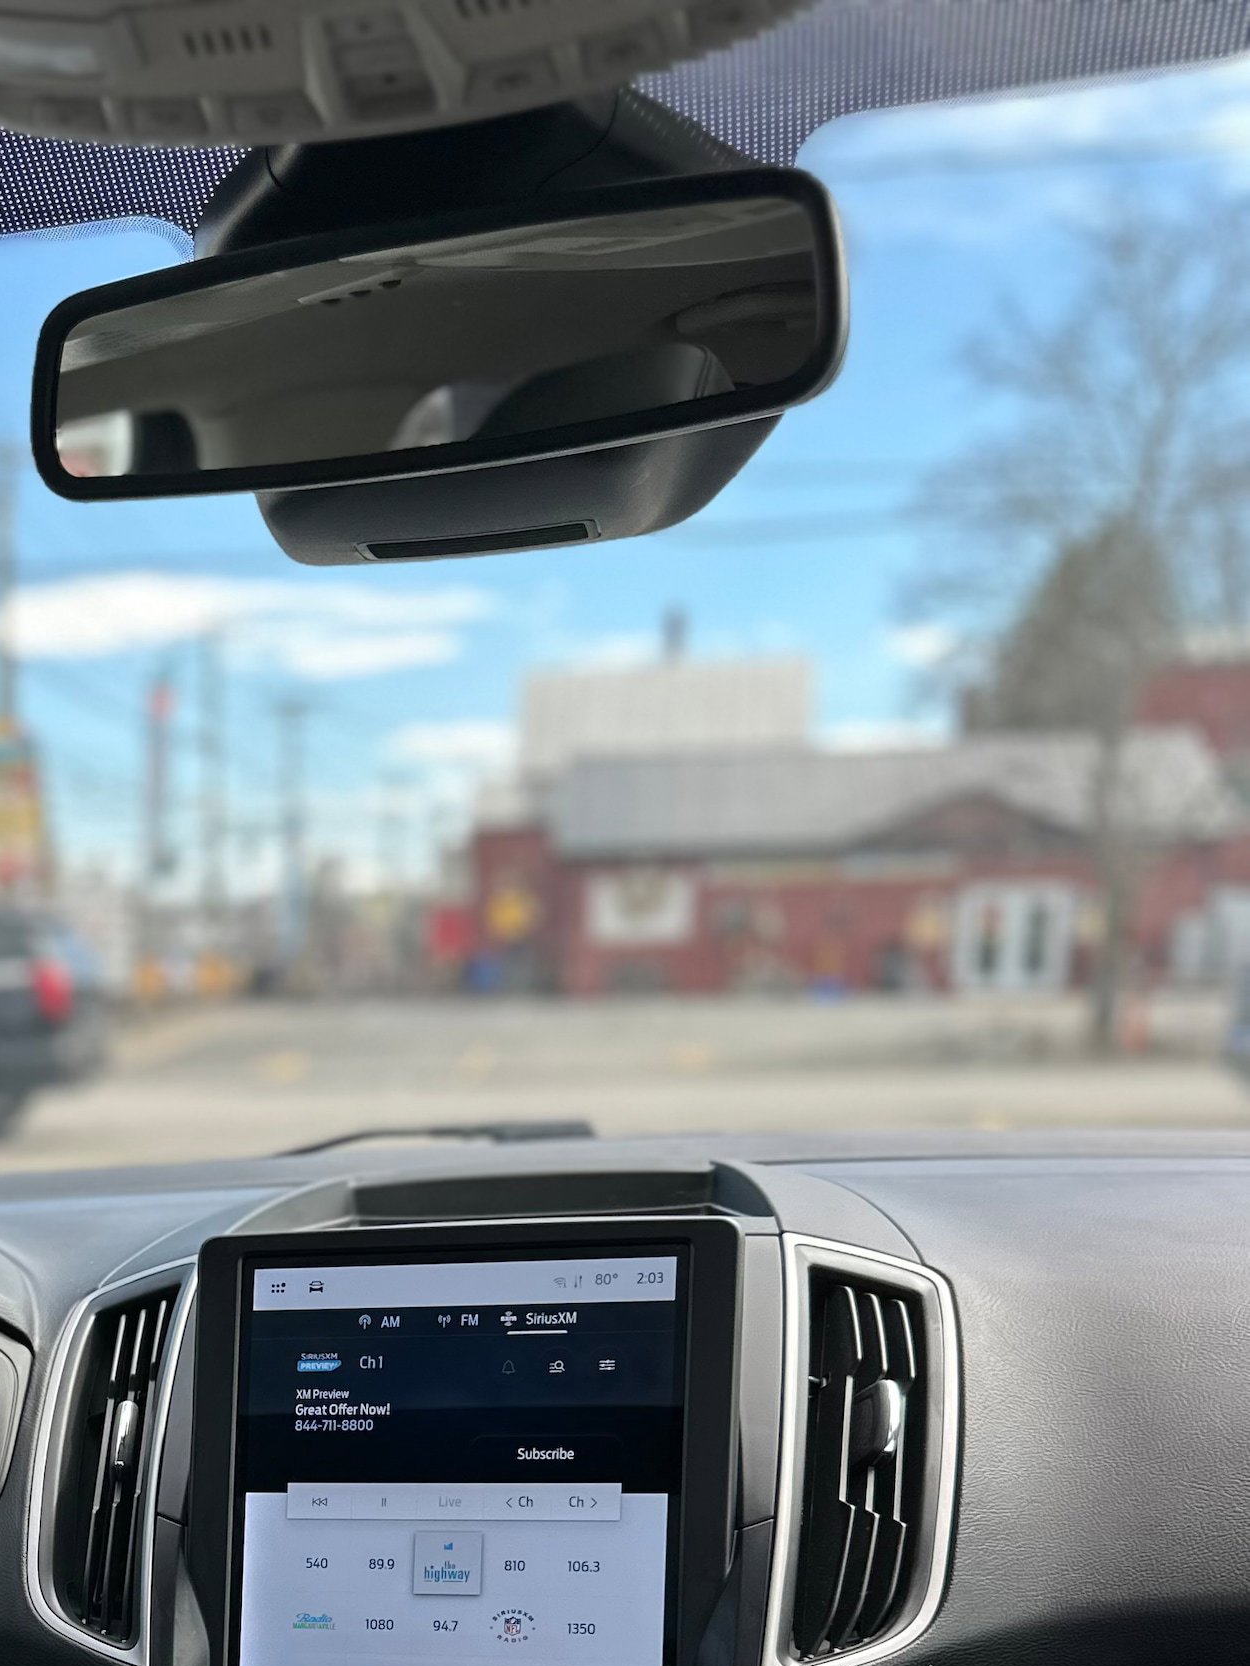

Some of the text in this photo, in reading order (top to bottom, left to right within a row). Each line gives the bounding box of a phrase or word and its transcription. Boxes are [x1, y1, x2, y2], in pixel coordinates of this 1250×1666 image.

[595, 1272, 664, 1285] 80° 2:03
[381, 1316, 400, 1328] AM
[461, 1314, 479, 1326] FM
[526, 1312, 577, 1325] SiriusXM
[360, 1356, 383, 1369] Ch 1
[296, 1389, 349, 1400] XM Preview
[295, 1403, 390, 1416] Great Offer Now!
[295, 1420, 373, 1431] 844-711-8800
[517, 1447, 574, 1460] Subscribe
[438, 1496, 584, 1508] Live Ch Ch
[305, 1558, 328, 1570] 540
[368, 1558, 395, 1570] 89.9
[504, 1560, 525, 1572] 810
[567, 1561, 601, 1573] 106.3
[424, 1565, 470, 1583] highway
[296, 1612, 333, 1624] Radio
[365, 1619, 394, 1631] 1080
[433, 1620, 458, 1633] 94.7
[506, 1624, 519, 1634] NFL
[568, 1624, 596, 1635] 1350
[497, 1635, 529, 1643] RADIO
